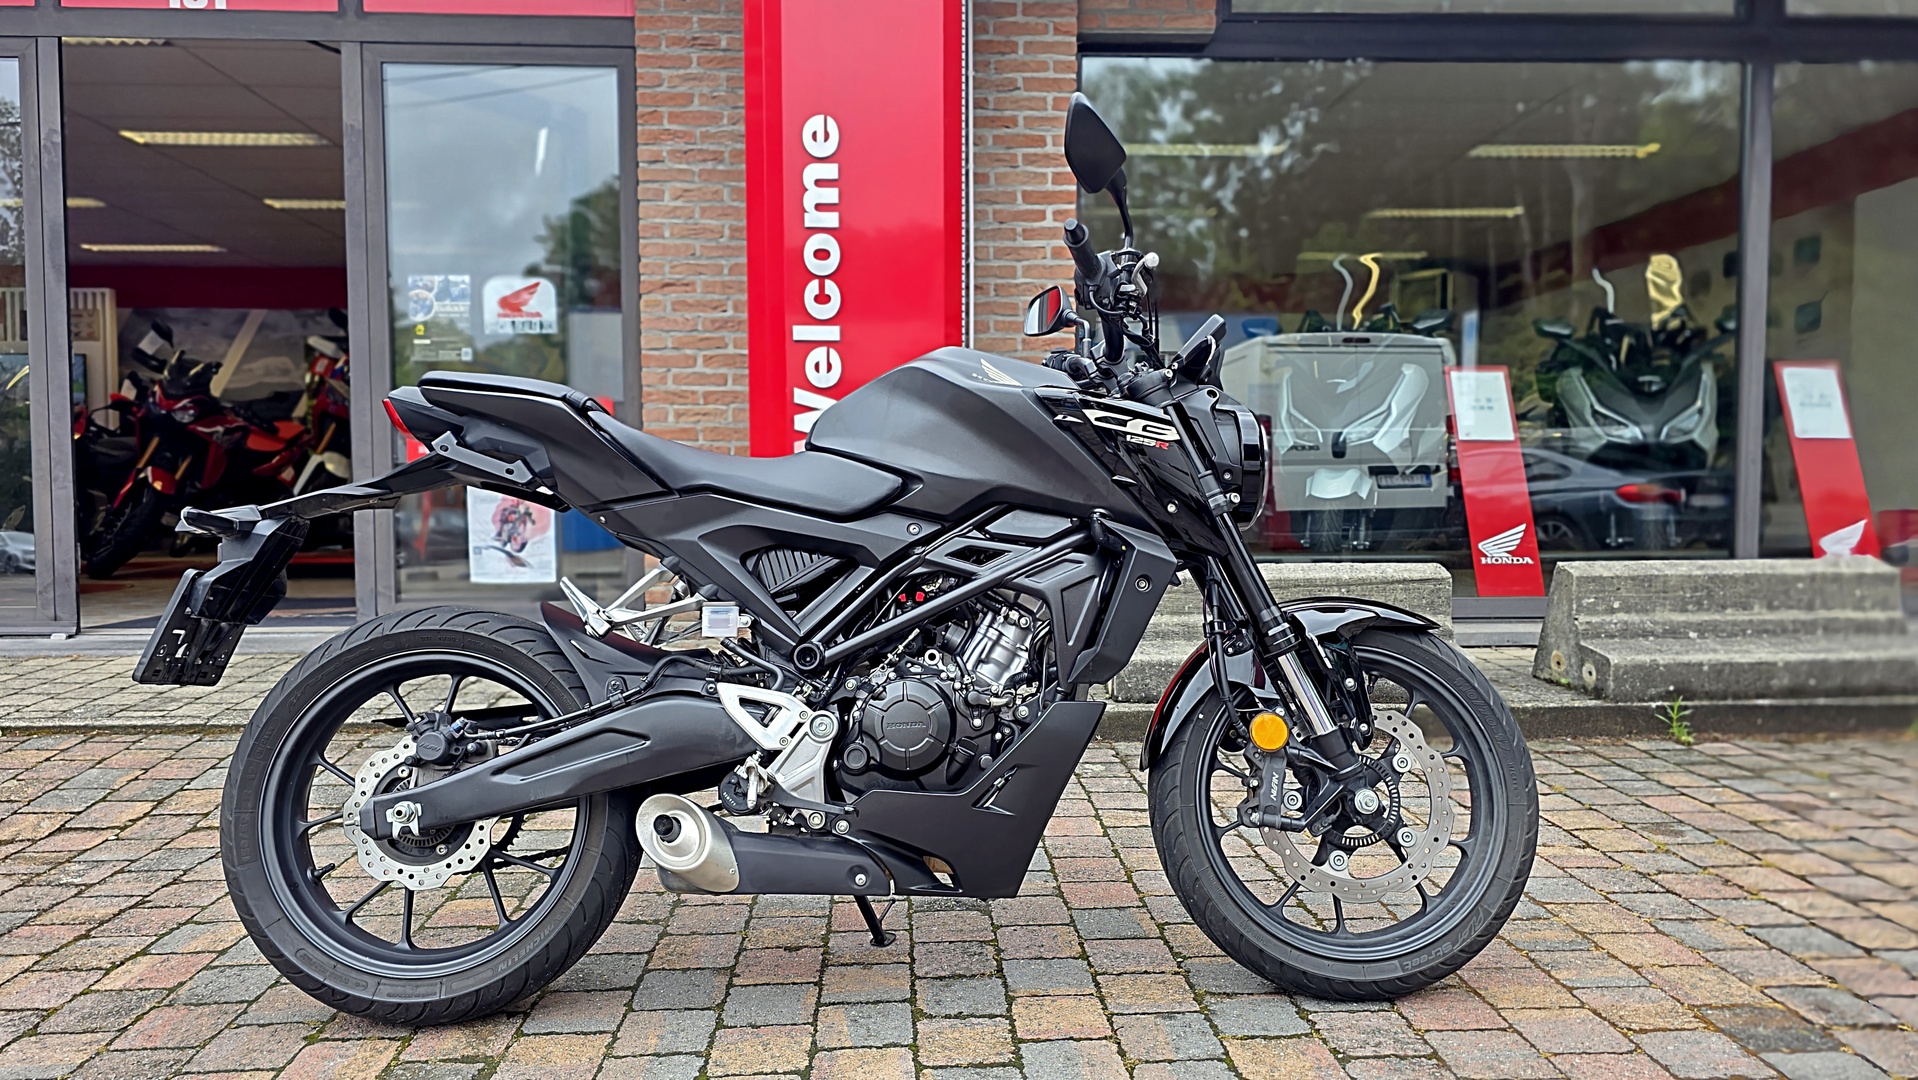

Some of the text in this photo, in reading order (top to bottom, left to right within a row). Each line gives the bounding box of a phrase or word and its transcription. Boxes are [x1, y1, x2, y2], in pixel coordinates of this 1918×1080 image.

[792, 114, 842, 454] Welcome
[1082, 408, 1181, 441] CB
[1126, 434, 1169, 450] 125R
[1480, 556, 1534, 565] HONDA
[886, 721, 927, 730] HONDA
[498, 922, 556, 972] MICHELIN
